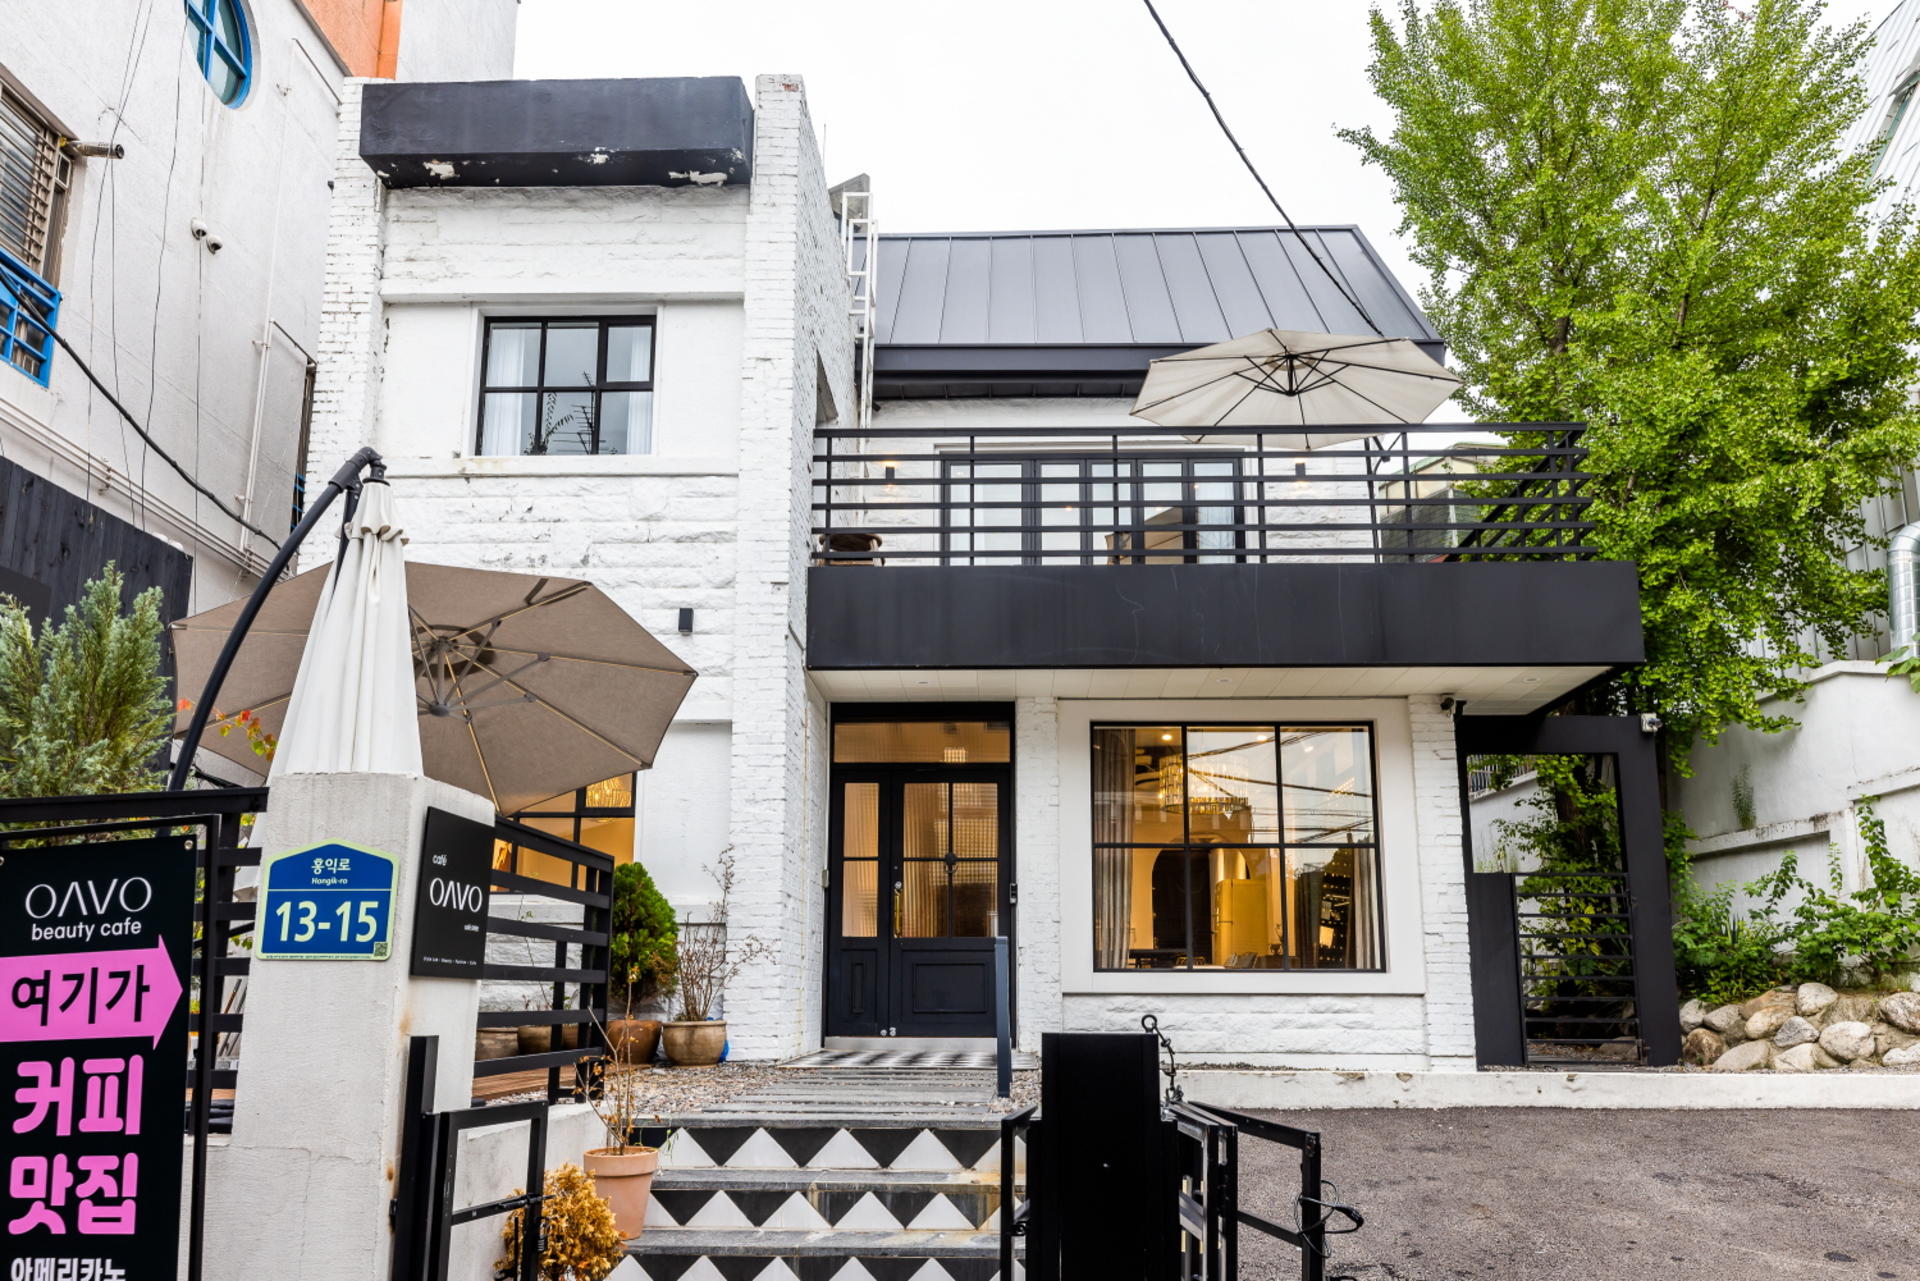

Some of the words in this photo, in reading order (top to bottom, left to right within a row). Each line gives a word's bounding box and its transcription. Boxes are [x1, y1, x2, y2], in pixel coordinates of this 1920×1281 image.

[311, 857, 352, 875] 홍익로
[31, 922, 95, 942] beauty
[100, 916, 142, 937] cafe
[275, 900, 379, 943] 13-15
[11, 964, 151, 1027] 여기가
[12, 1054, 144, 1137] 커피
[8, 1152, 139, 1235] 맛집
[10, 1257, 126, 1281] 아메리카노
